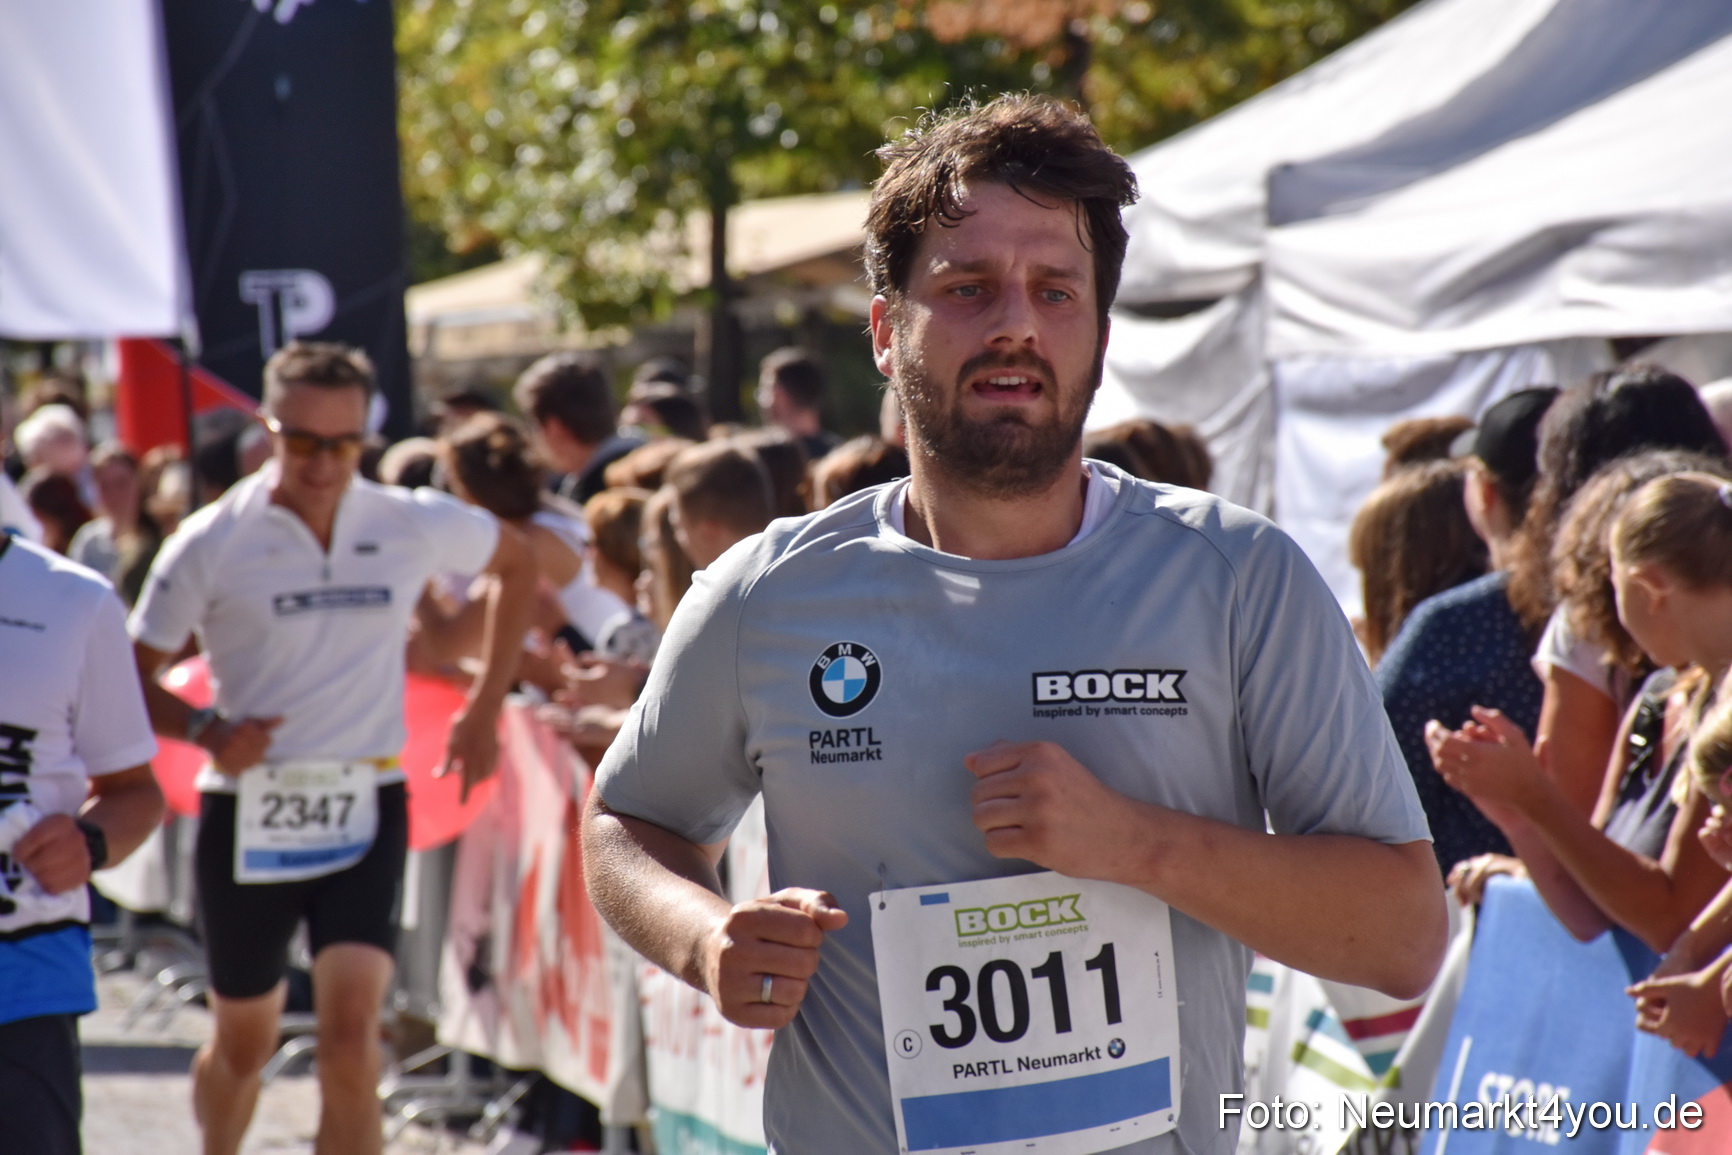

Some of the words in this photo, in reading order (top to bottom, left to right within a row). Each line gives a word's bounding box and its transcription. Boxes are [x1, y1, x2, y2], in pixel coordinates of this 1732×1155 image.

[817, 643, 876, 670] BMW
[1032, 669, 1188, 705] BOCK
[1033, 706, 1082, 720] inspired
[1086, 705, 1101, 717] by
[1104, 705, 1137, 716] smart
[1140, 706, 1188, 718] concepts
[809, 727, 882, 750] PARTL
[810, 747, 882, 765] Neumarkt
[261, 792, 355, 830] 2347
[955, 893, 1086, 937] BOCK
[958, 936, 997, 948] inspired
[999, 935, 1011, 944] by
[1013, 930, 1042, 941] smart
[1045, 924, 1089, 937] concepts
[925, 942, 1122, 1049] 3011
[903, 1037, 913, 1052] C
[953, 1059, 1013, 1079] PARTL
[1017, 1046, 1102, 1072] Neumarkt
